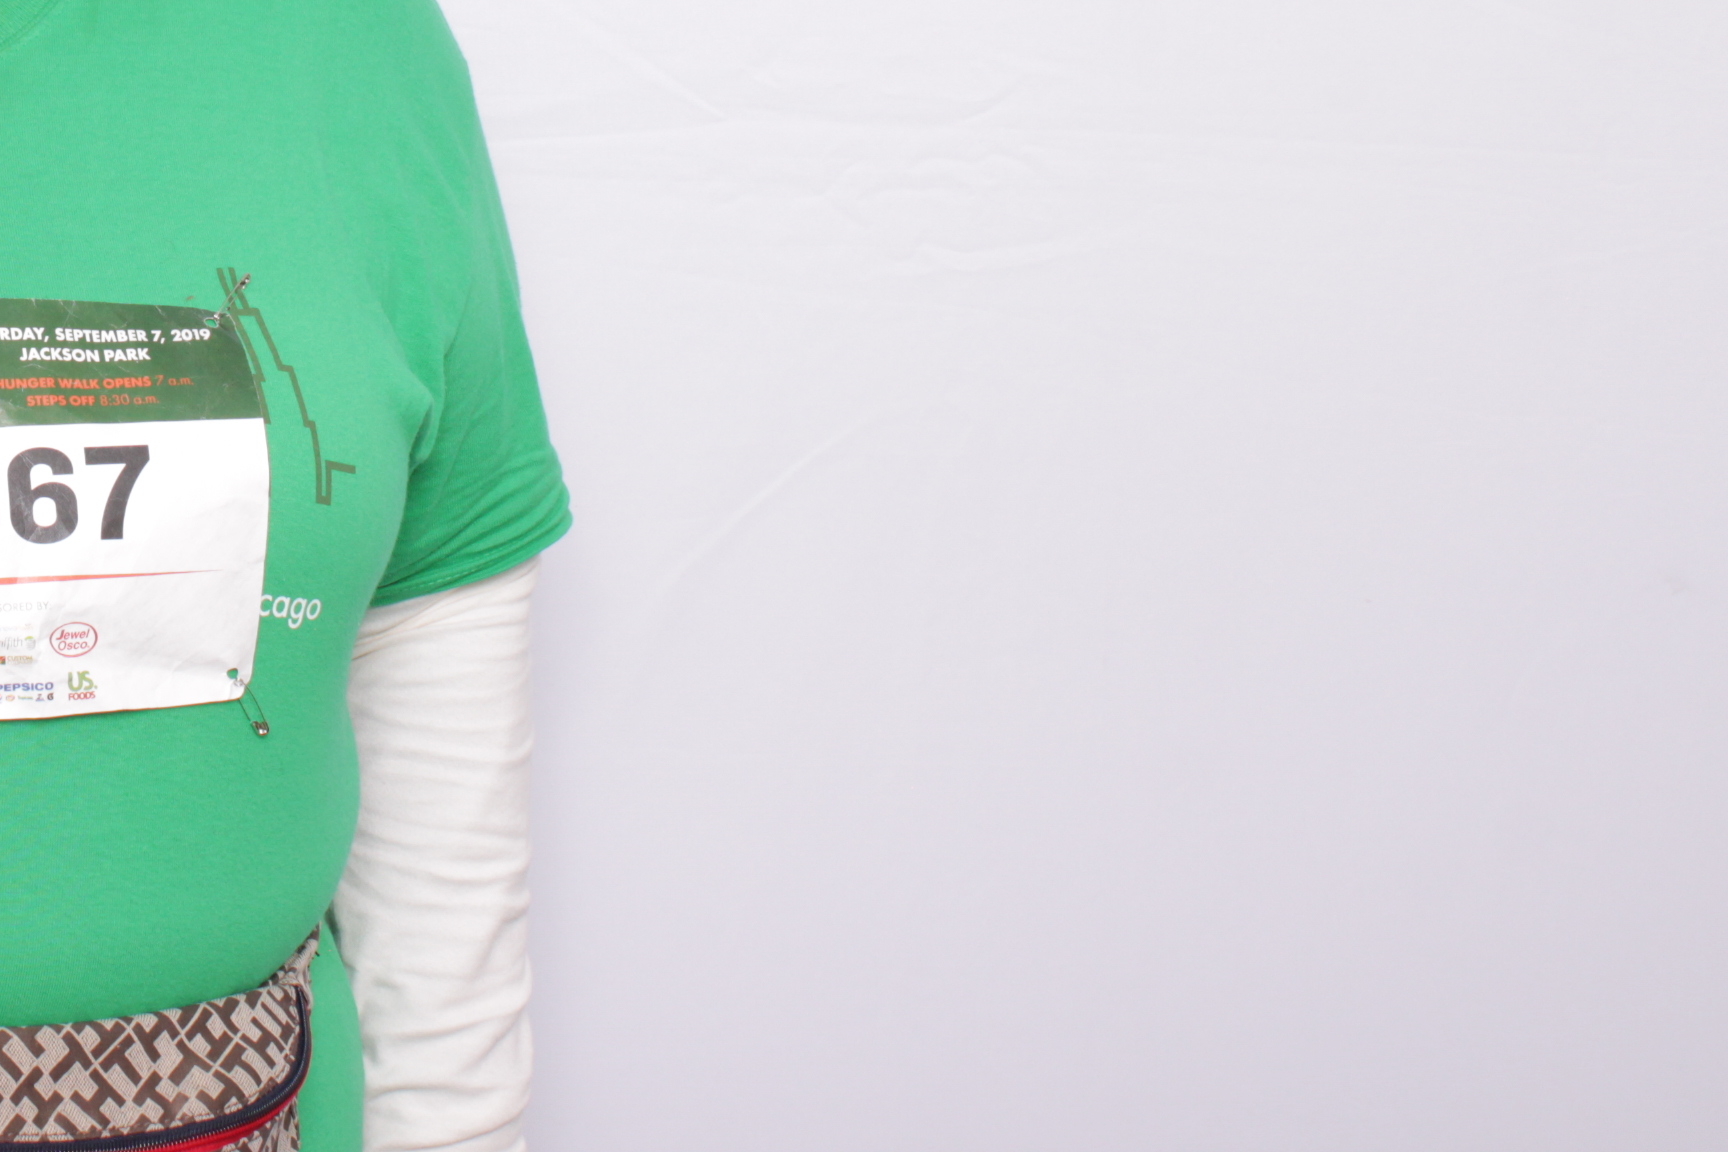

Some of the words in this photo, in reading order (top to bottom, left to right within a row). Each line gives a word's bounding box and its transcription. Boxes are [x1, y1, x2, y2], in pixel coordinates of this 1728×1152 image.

[55, 327, 148, 343] SEPTEMBER
[150, 329, 166, 344] 7,
[172, 328, 211, 342] 2019
[20, 347, 100, 362] JACKSON
[104, 348, 151, 362] PARK
[58, 377, 100, 390] WALK
[102, 376, 152, 389] OPENS
[155, 375, 165, 387] 7
[168, 377, 194, 387] a.m.
[26, 395, 67, 407] STEPS
[69, 395, 96, 407] OFF
[100, 394, 130, 406] 8:30
[133, 395, 160, 406] a.m.
[55, 629, 90, 641] Jewel
[68, 691, 96, 701] FOODS
